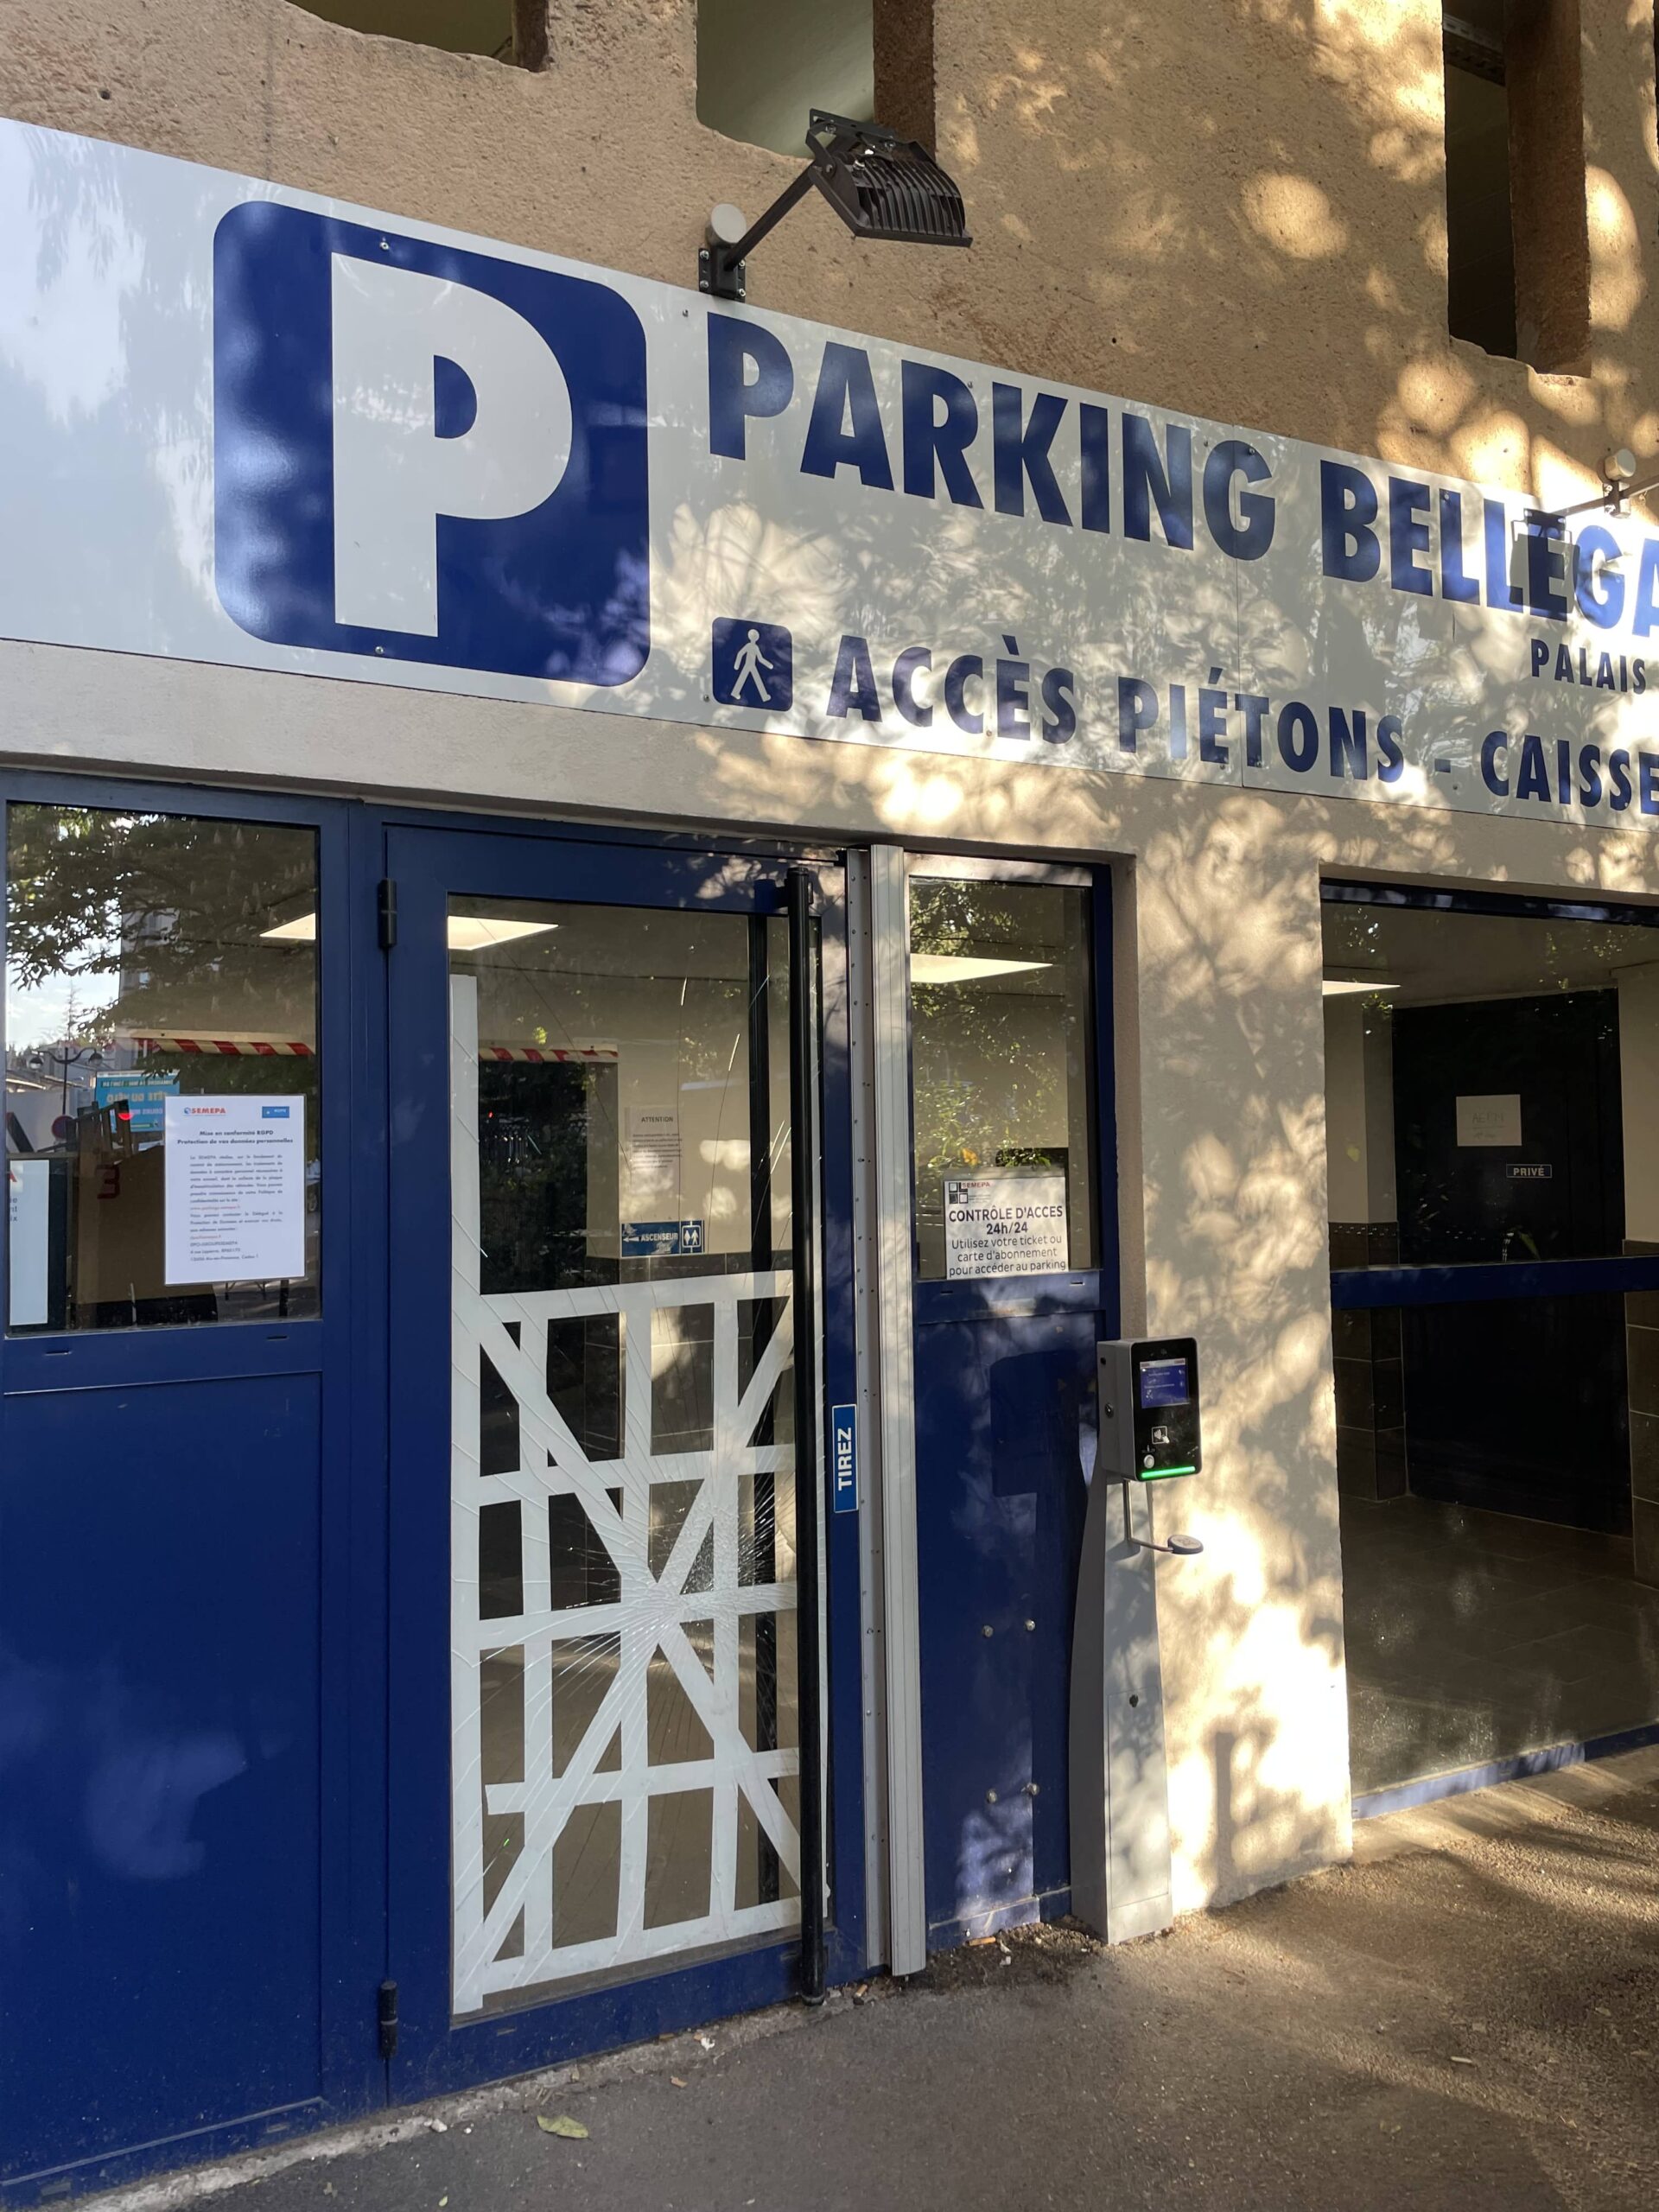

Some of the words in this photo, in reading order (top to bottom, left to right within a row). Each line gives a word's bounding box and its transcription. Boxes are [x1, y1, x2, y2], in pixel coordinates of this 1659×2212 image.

[331, 251, 573, 638] P
[707, 311, 1276, 561] PARKING
[1530, 639, 1645, 695] PALAIS
[825, 634, 1077, 745] ACCÈS
[1117, 667, 1404, 783] PIÉTONS
[1480, 730, 1659, 815] CAISSE
[1513, 1165, 1545, 1177] PRIVÉ
[949, 1205, 1013, 1223] CONTRÔLE
[1015, 1205, 1063, 1219] D'ACCES
[640, 1232, 678, 1242] ASCENSEUR
[986, 1222, 1028, 1235] 24h/24
[951, 1236, 988, 1249] Utilisez
[991, 1237, 1018, 1247] votre
[1020, 1235, 1048, 1245] ticket
[957, 1251, 984, 1262] carte
[986, 1248, 1058, 1261] d'abonnement
[950, 1266, 973, 1278] pour
[975, 1262, 1014, 1274] accéder
[1030, 1260, 1066, 1273] parking
[837, 1427, 853, 1491] TIREZ
